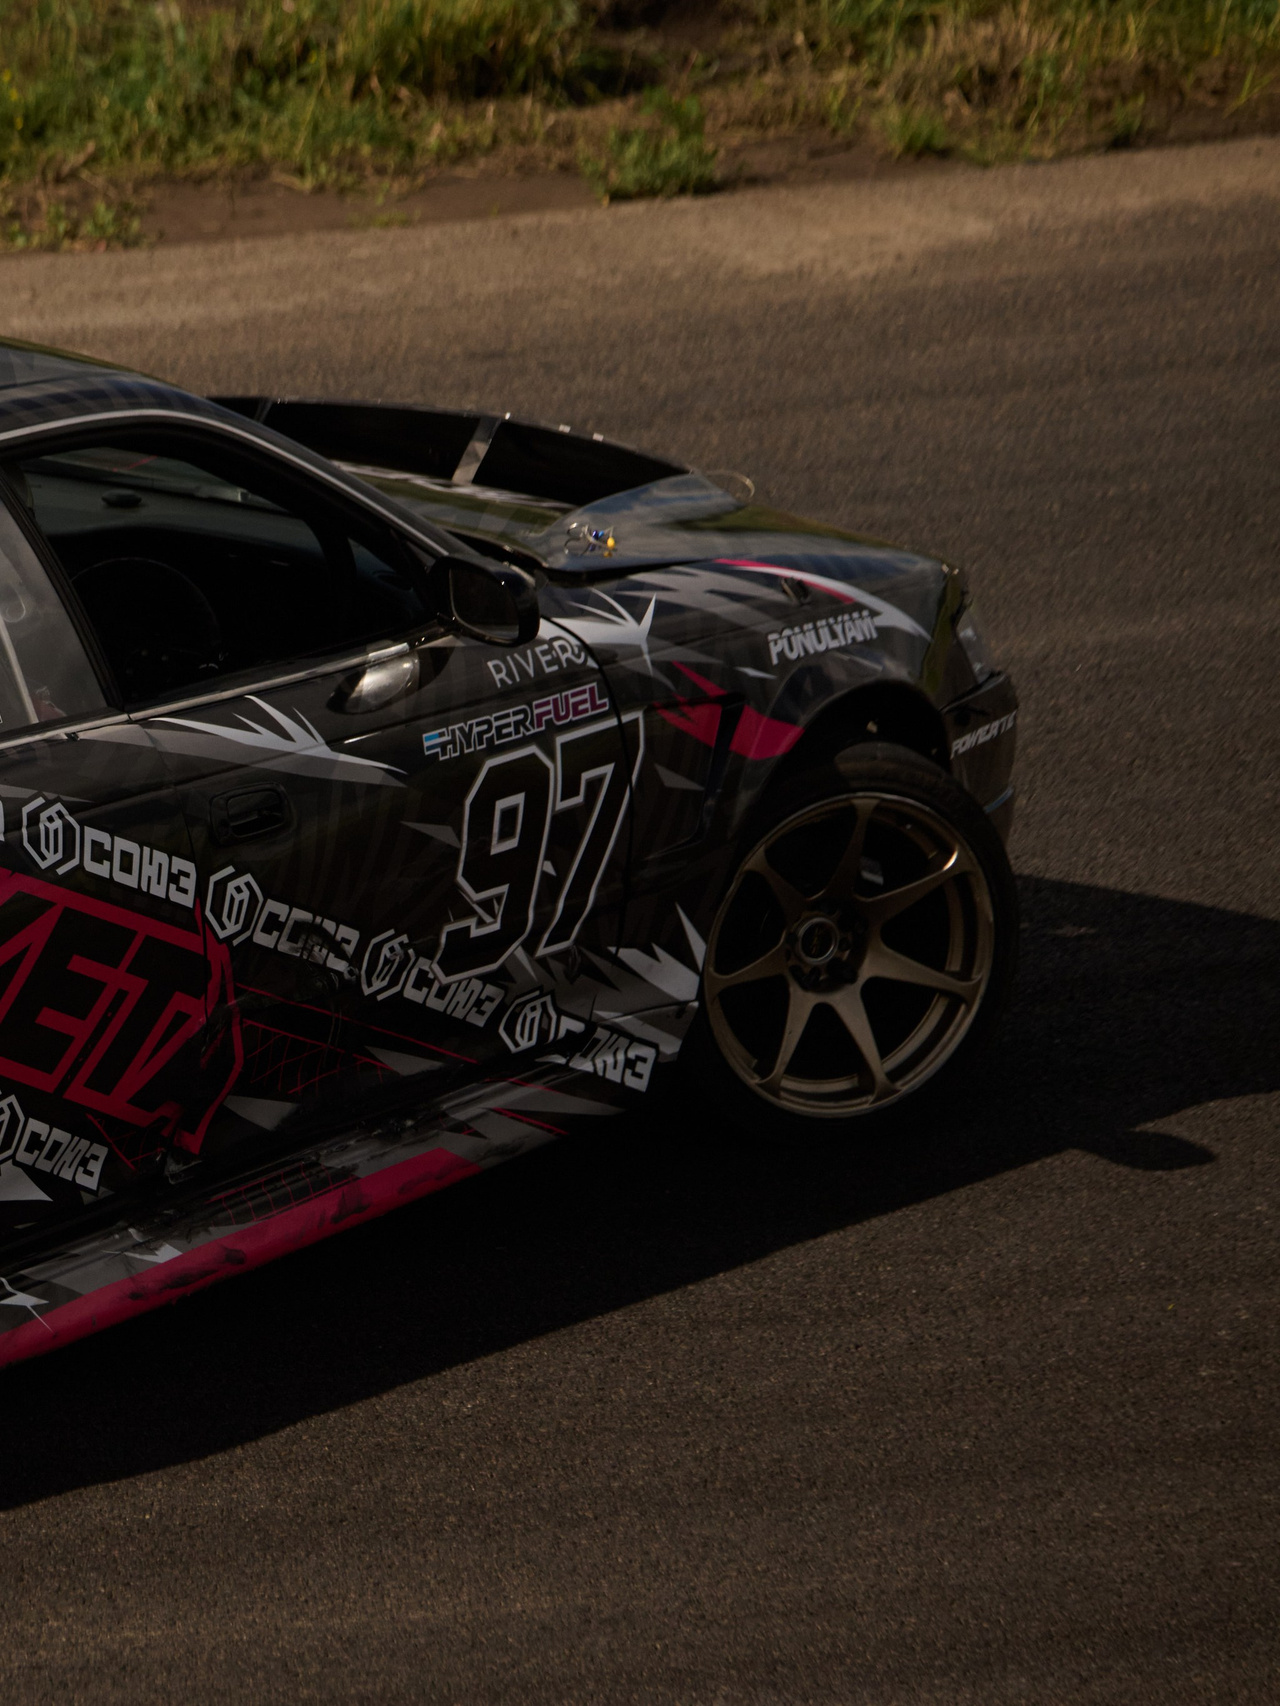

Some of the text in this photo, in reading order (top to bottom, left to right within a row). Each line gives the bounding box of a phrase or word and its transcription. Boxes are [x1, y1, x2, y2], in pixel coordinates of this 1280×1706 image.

[768, 609, 878, 666] PONULYAM
[83, 825, 197, 910] СОЮЗ
[428, 707, 647, 987] 97
[15, 1116, 109, 1192] СОЮЗ
